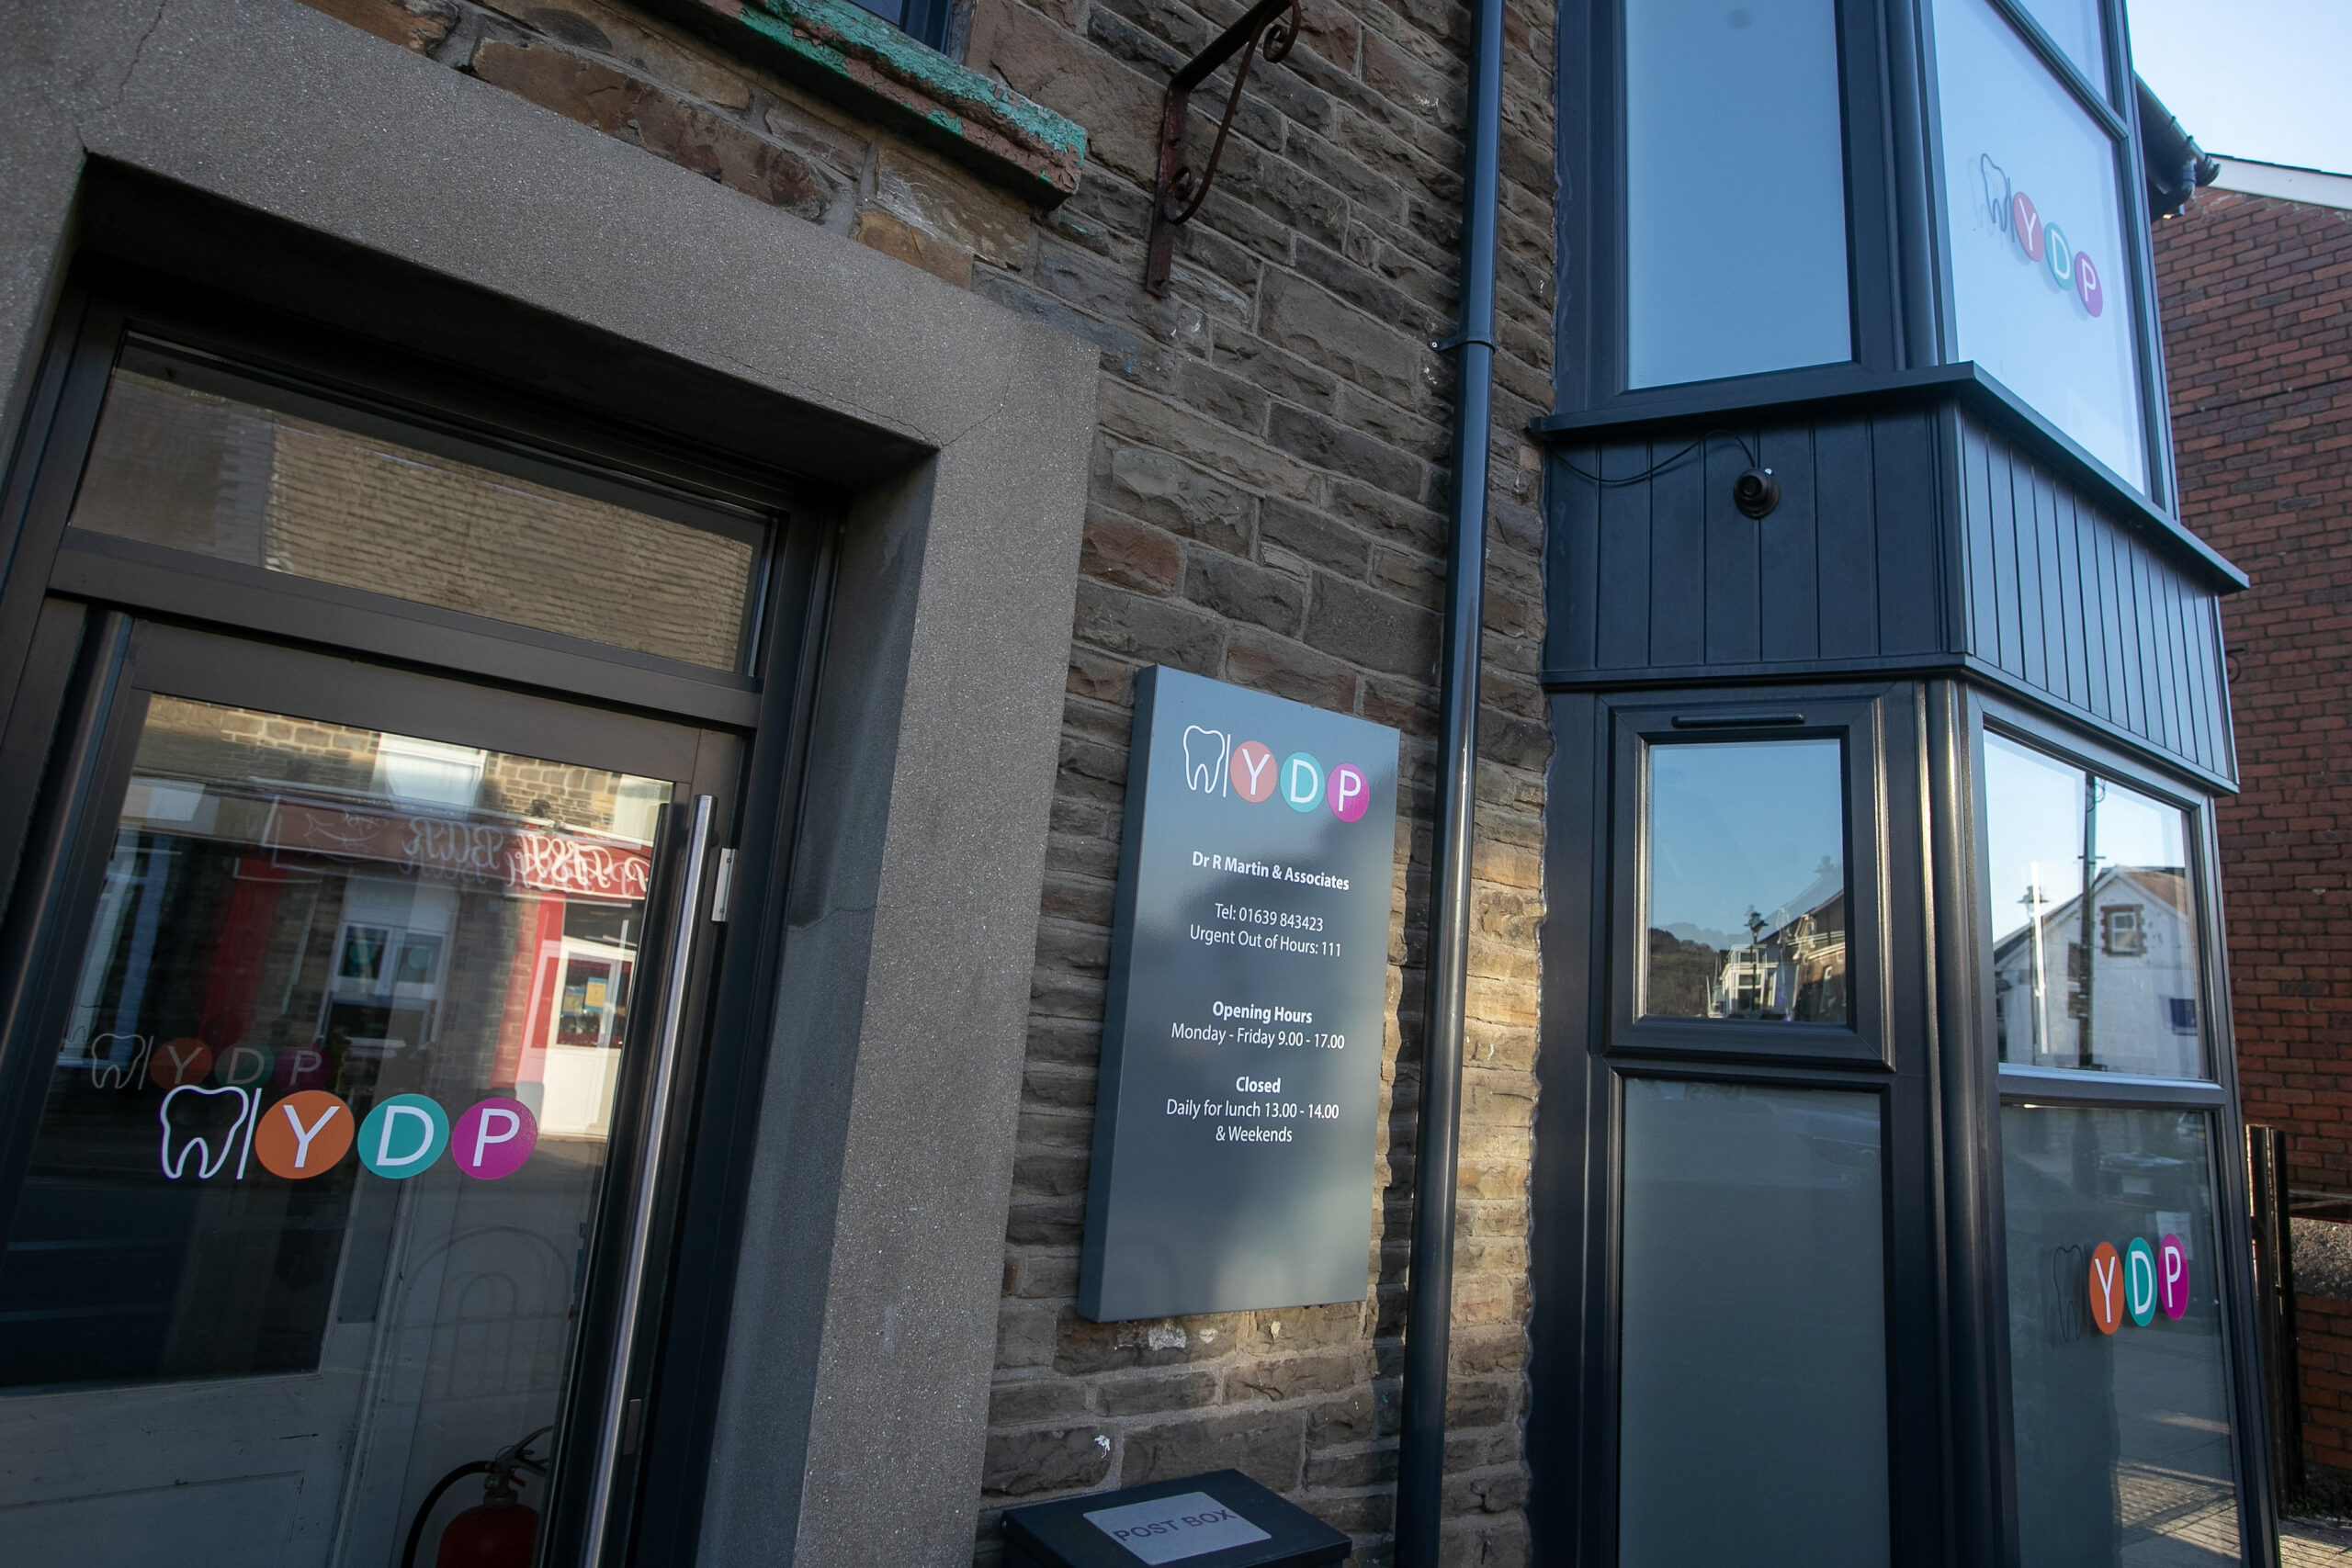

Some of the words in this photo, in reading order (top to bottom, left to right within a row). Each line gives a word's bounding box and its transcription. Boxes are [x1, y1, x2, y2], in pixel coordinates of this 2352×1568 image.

[1241, 748, 1362, 812] YDP
[1192, 851, 1212, 868] Dr
[1212, 854, 1222, 869] R
[1224, 857, 1270, 878] Martin
[1272, 864, 1283, 880] &
[1284, 866, 1350, 891] Associates
[1215, 902, 1237, 920] Tel:
[1238, 906, 1277, 926] 01639
[1280, 911, 1324, 932] 843423
[1190, 924, 1236, 946] Urgent
[1238, 930, 1262, 948] Out
[1264, 933, 1278, 950] of
[1280, 936, 1319, 955] Hours:
[1320, 941, 1342, 957] 111
[1212, 999, 1272, 1024] Opening
[1273, 1006, 1313, 1023] Hours
[1170, 1022, 1227, 1044] Monday
[1237, 1027, 1275, 1048] Friday
[1277, 1031, 1304, 1047] 9.00
[1314, 1033, 1345, 1049] 17.00
[1235, 1076, 1282, 1093] Closed
[1166, 1099, 1202, 1119] Daily
[1203, 1099, 1223, 1117] for
[1225, 1100, 1261, 1118] lunch
[1264, 1102, 1297, 1119] 13.00
[1307, 1103, 1340, 1119] 14.00
[281, 1103, 521, 1169] YDP
[1215, 1126, 1226, 1142] &
[1227, 1125, 1293, 1142] Weekends
[2094, 1246, 2182, 1324] YDP
[1112, 1518, 1182, 1542] POST
[1181, 1508, 1238, 1528] BOX
